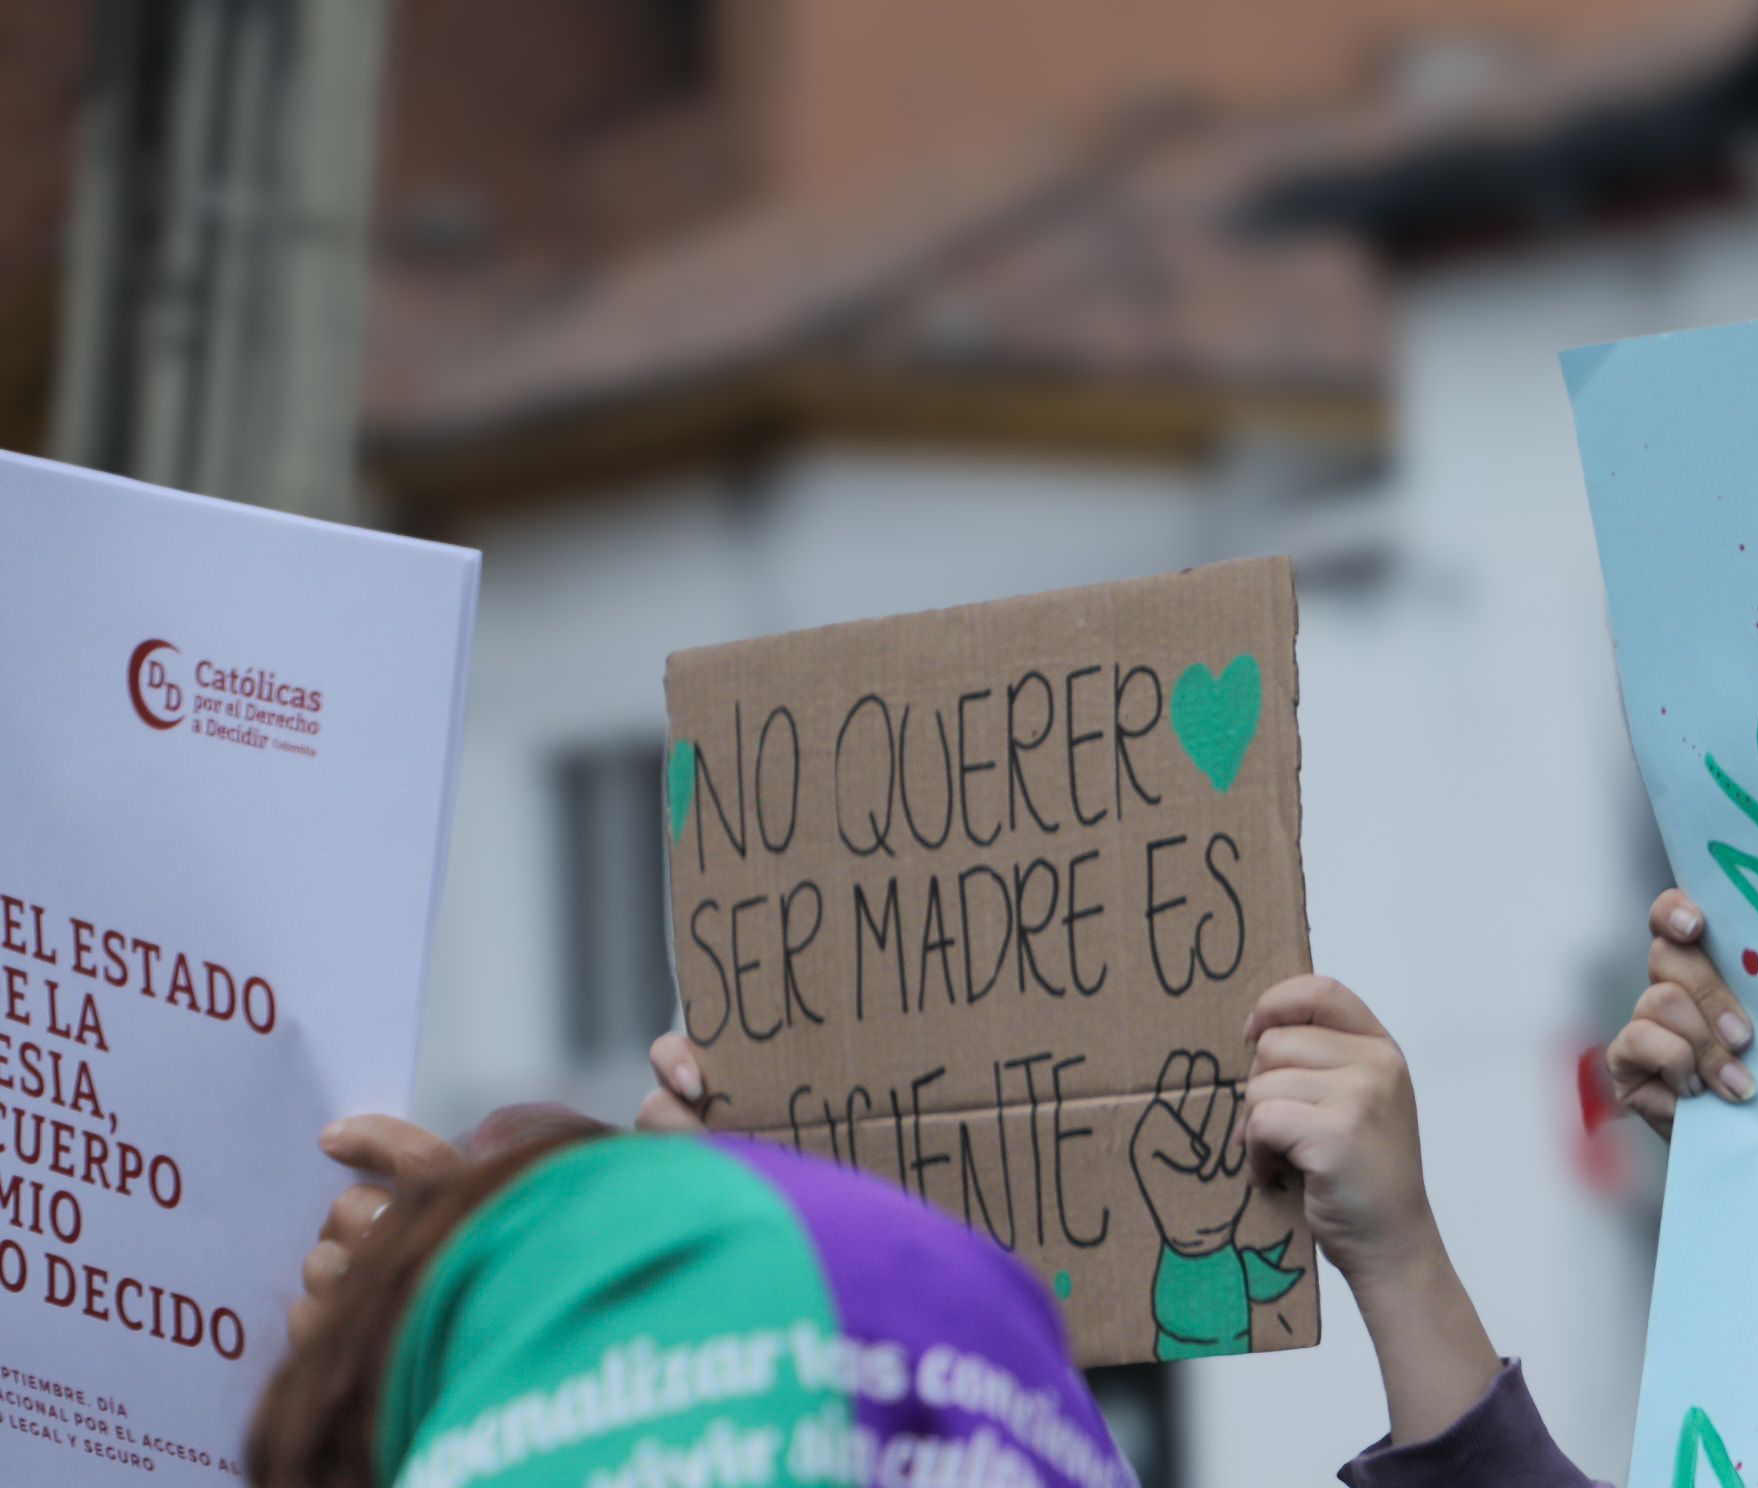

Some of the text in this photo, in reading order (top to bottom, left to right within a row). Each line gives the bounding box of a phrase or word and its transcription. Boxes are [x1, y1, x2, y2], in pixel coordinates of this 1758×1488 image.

[193, 694, 321, 736] por el Derecho
[194, 659, 323, 713] Católicas
[191, 719, 202, 734] a
[206, 718, 269, 750] Decidir
[692, 663, 1164, 873] NO QUERER
[0, 893, 276, 1036] EL ESTADO
[686, 833, 1246, 1047] SER MADRE ES
[44, 979, 110, 1053] LA
[0, 1101, 182, 1210] UERPO
[44, 1252, 246, 1362] DECIDO
[73, 1412, 108, 1436] POR
[114, 1424, 136, 1444] EL
[142, 1434, 212, 1467] ACCESO
[96, 1395, 129, 1419] DÍA
[9, 1413, 62, 1445] LEGAL
[67, 1432, 78, 1449] Y
[83, 1438, 155, 1473] SEGURO
